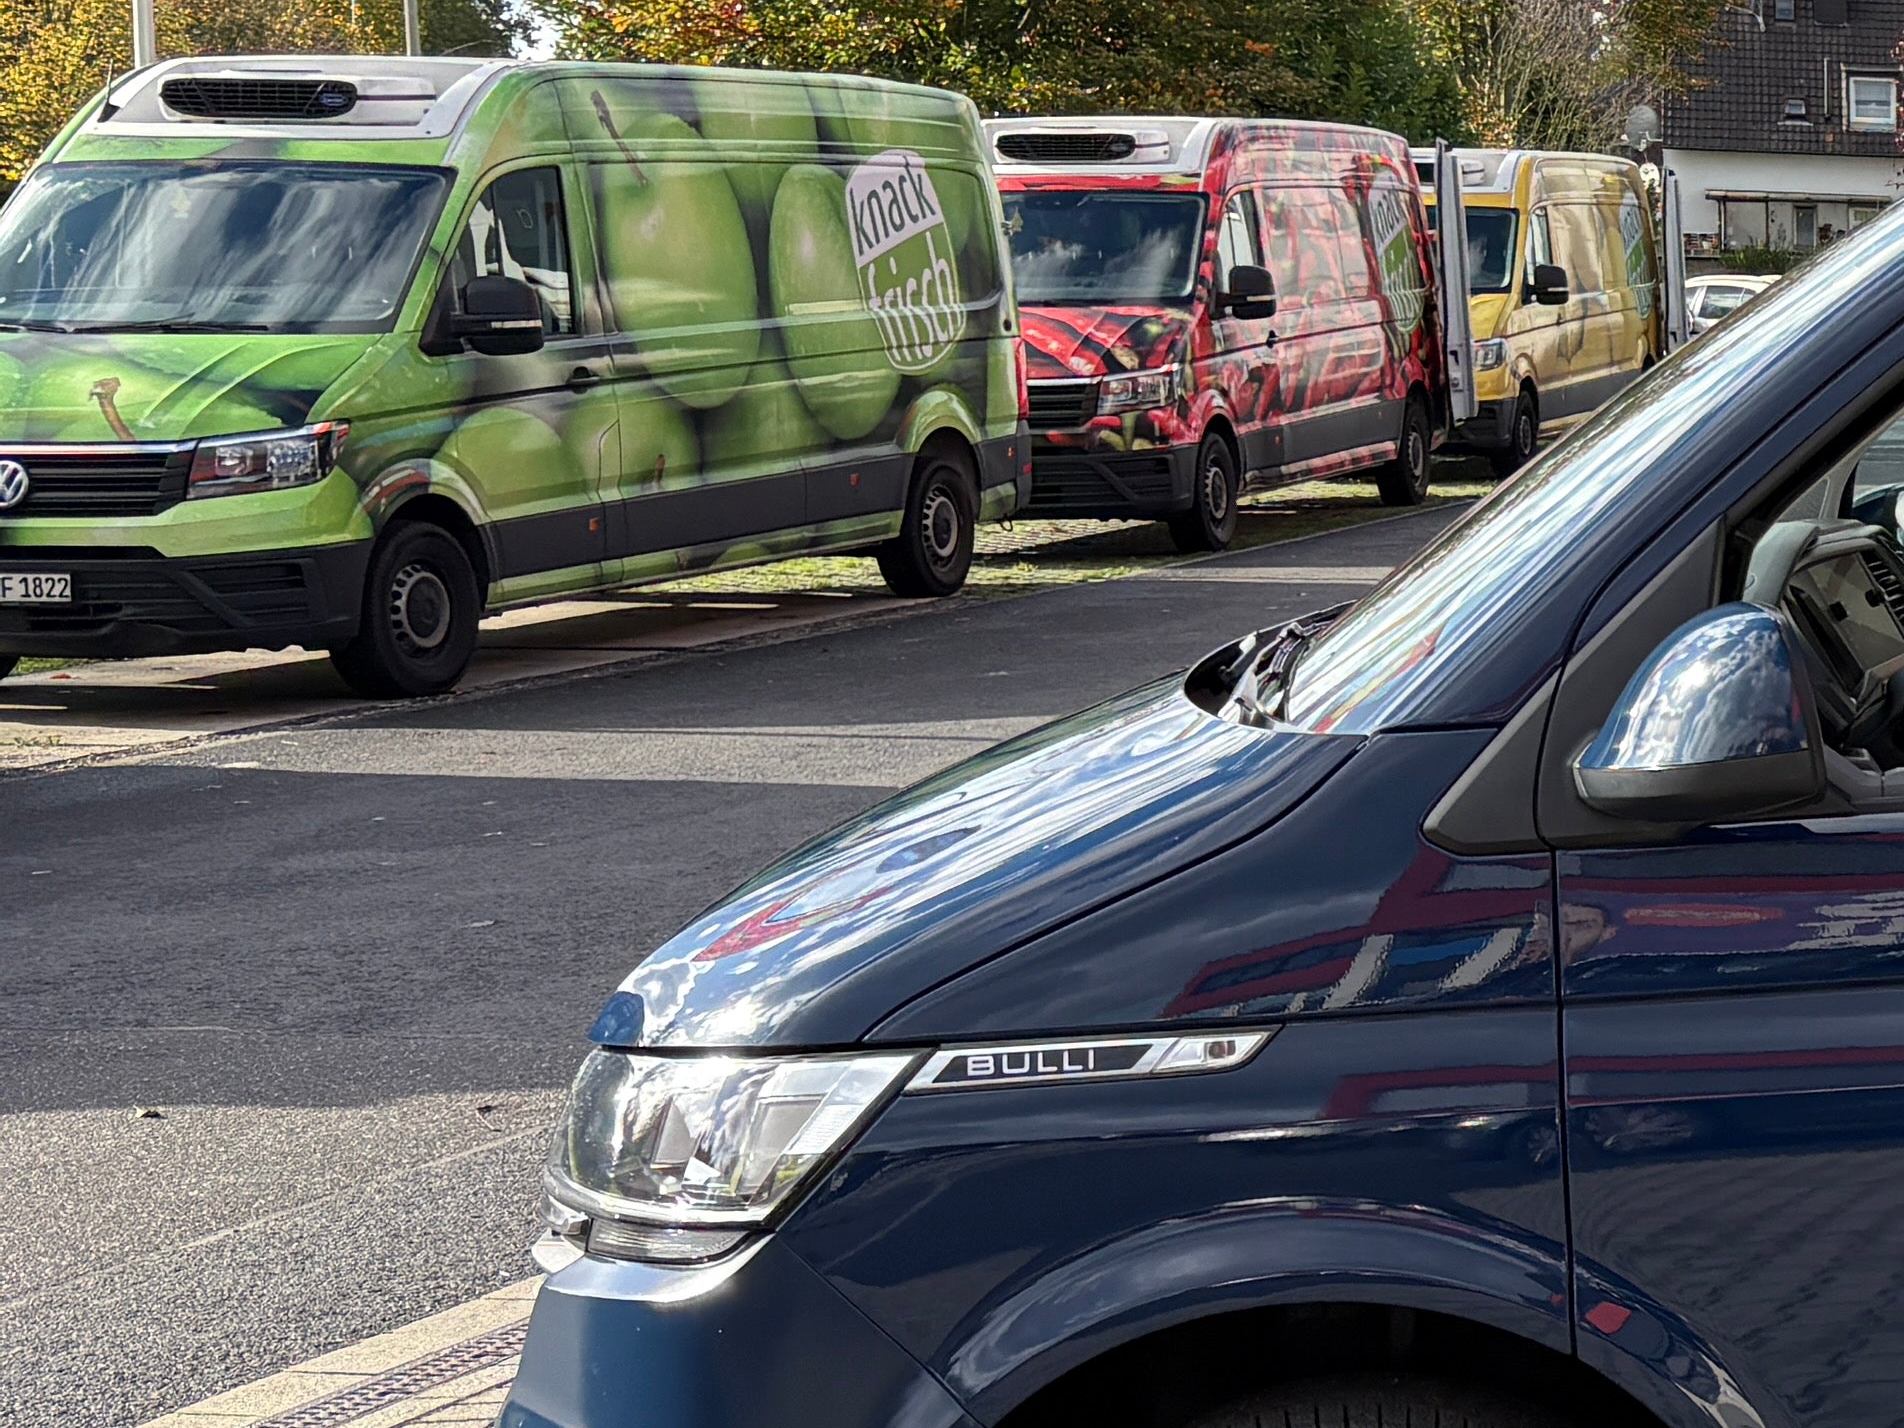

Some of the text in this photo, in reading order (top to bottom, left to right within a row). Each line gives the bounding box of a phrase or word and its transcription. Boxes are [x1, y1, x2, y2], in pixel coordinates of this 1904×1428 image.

[849, 155, 936, 256] knack
[869, 231, 961, 362] frisch
[19, 577, 70, 598] 1822
[967, 1049, 1095, 1076] BULLI
